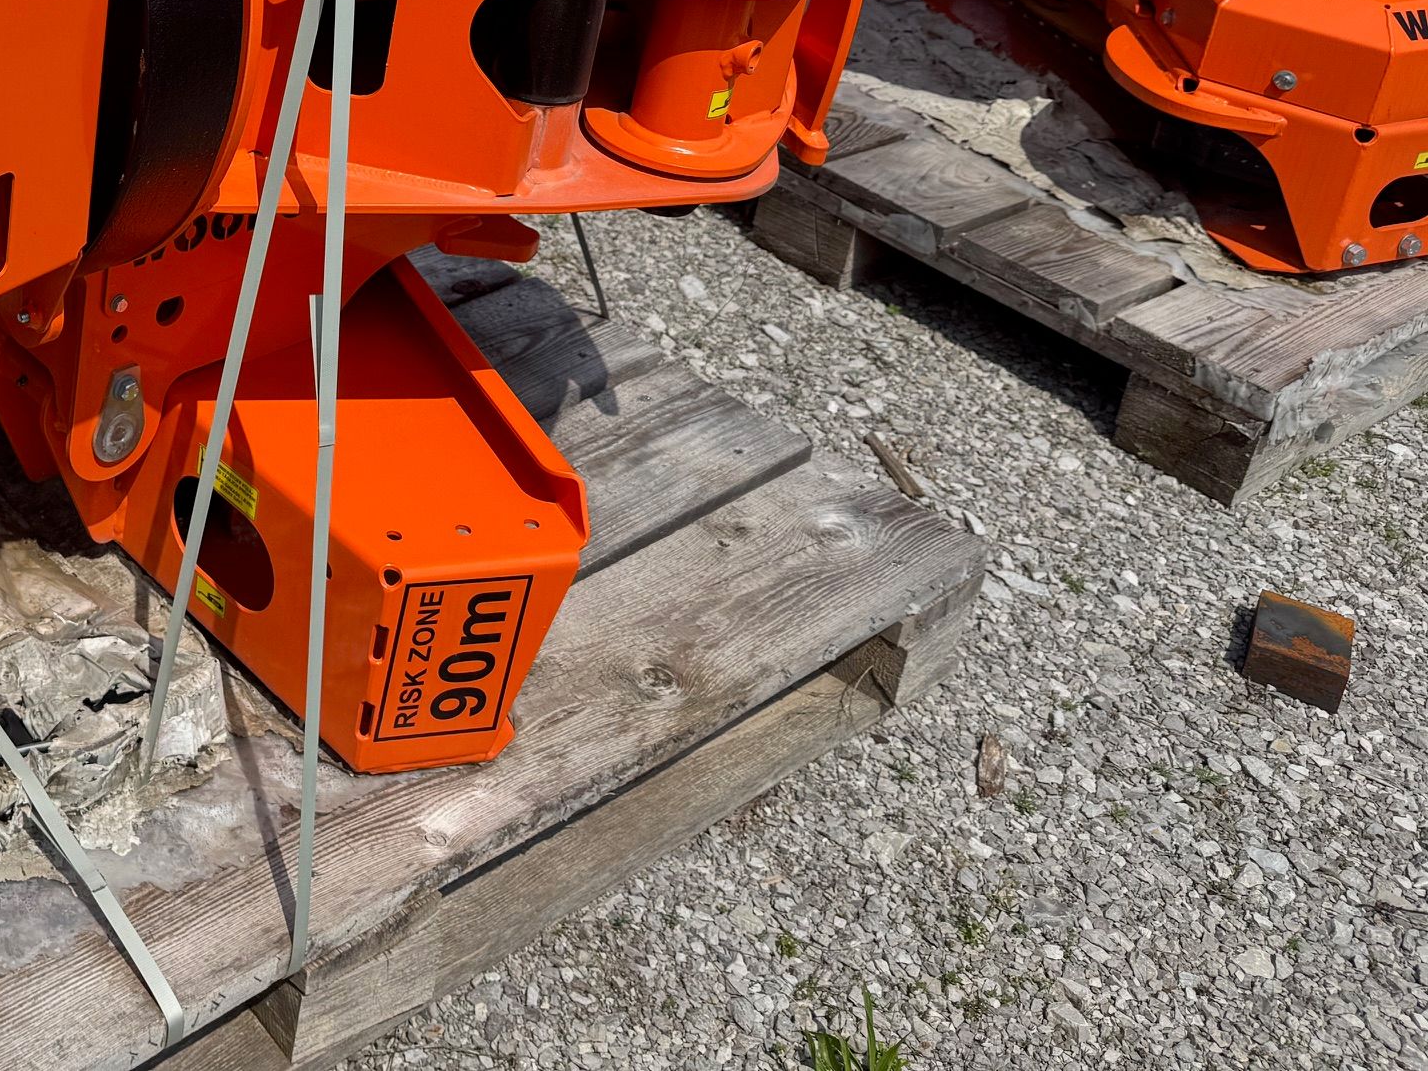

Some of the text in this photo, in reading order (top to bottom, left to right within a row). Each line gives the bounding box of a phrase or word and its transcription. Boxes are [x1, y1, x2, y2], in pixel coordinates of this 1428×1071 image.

[393, 590, 444, 729] RISK ZONE
[430, 591, 512, 720] 90m
